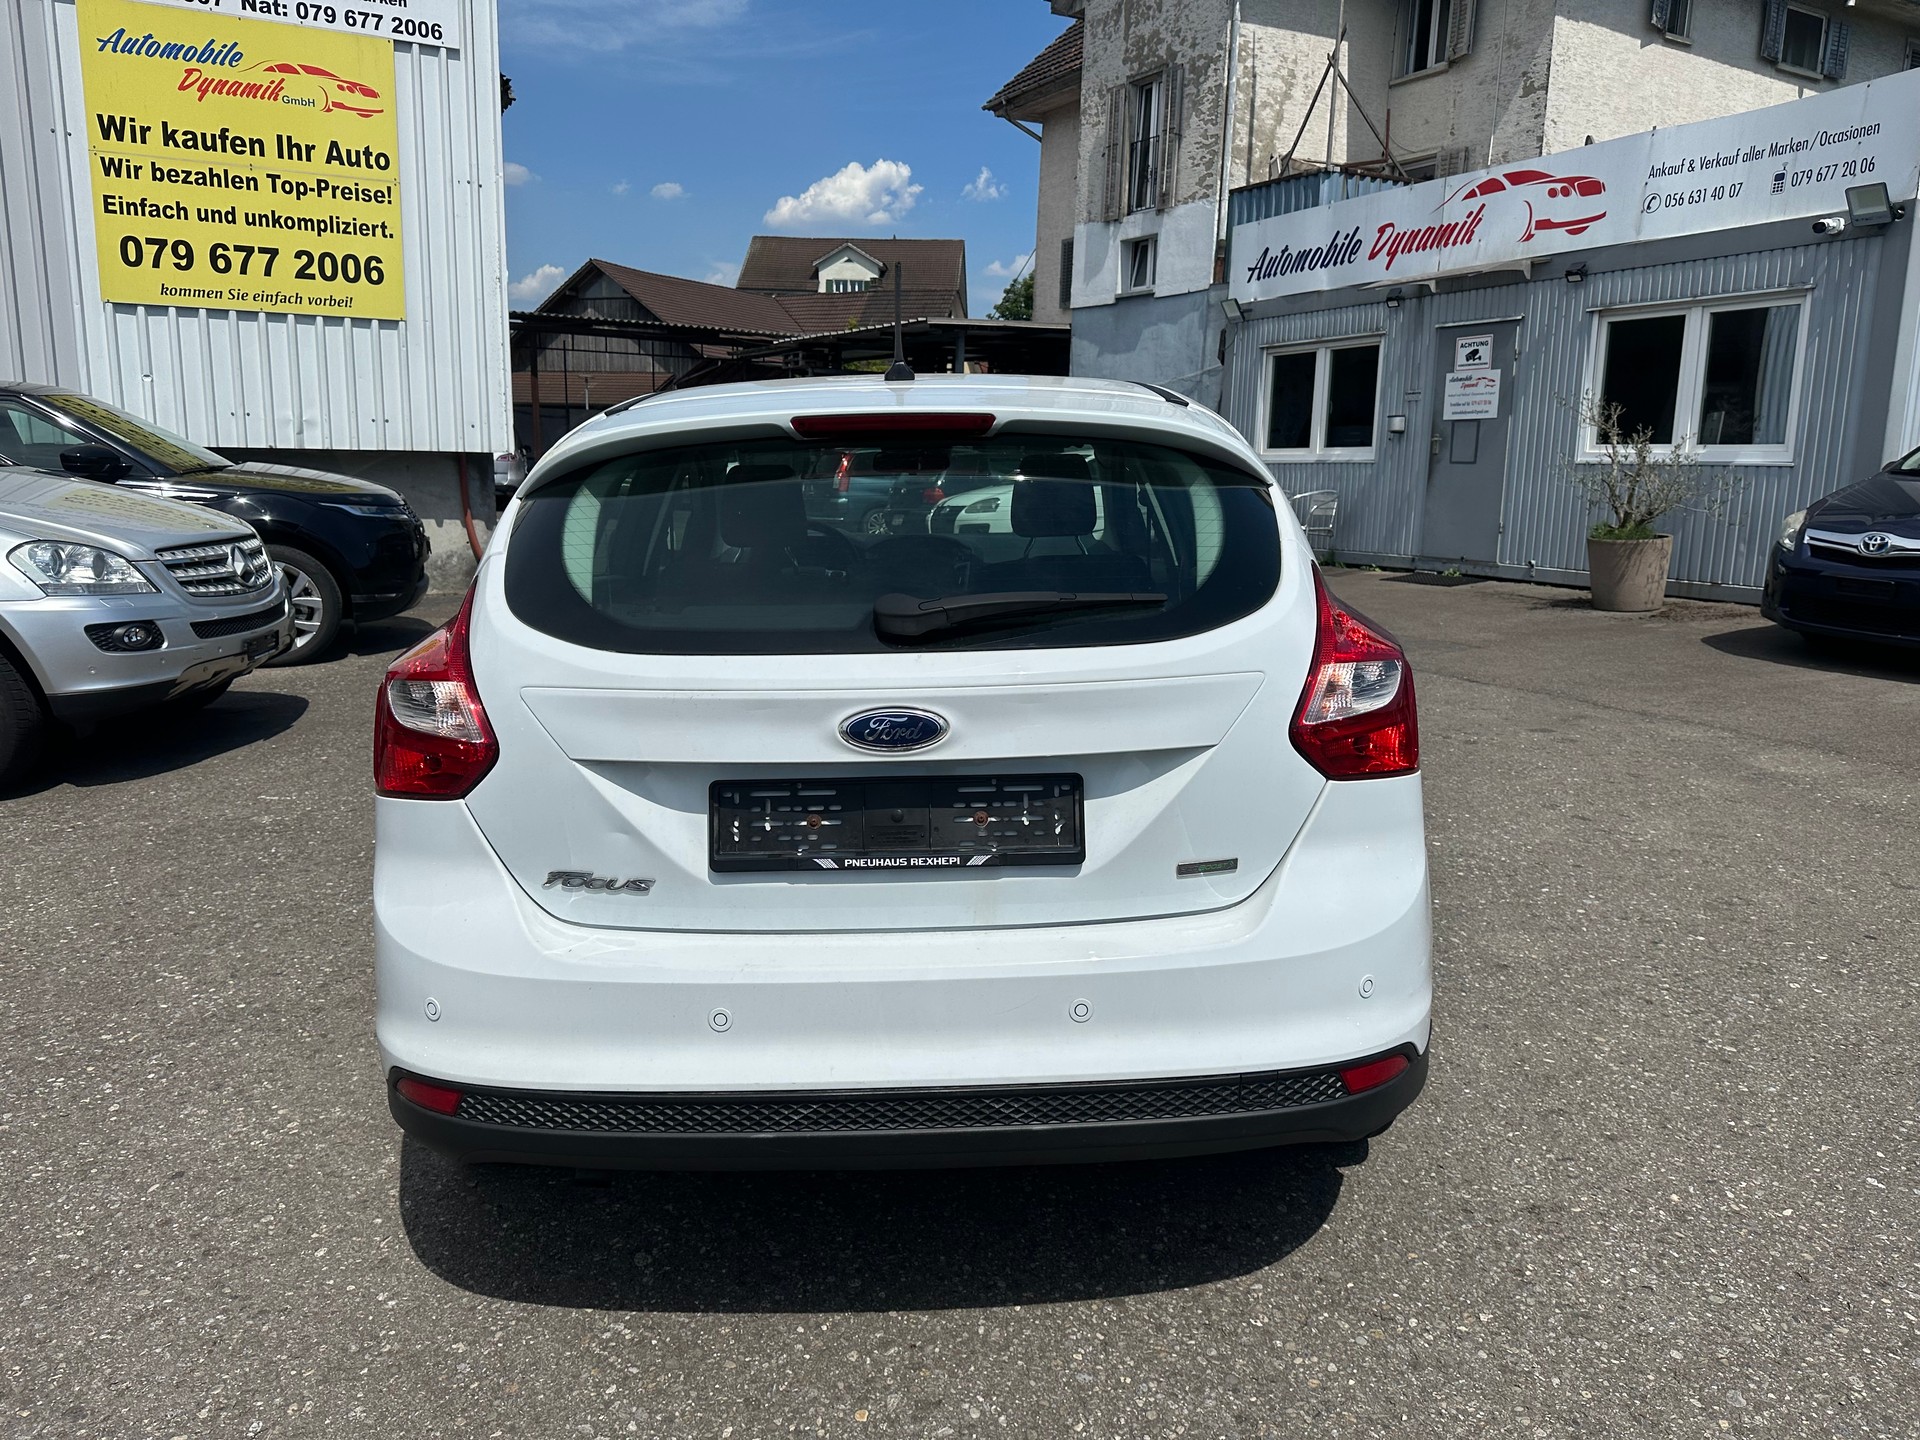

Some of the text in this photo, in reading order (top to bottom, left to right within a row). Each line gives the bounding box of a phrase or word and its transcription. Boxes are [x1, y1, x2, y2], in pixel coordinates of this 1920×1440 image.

[296, 1, 336, 24] 079
[344, 9, 384, 31] 677
[391, 16, 443, 40] 2006
[96, 28, 243, 67] Automobile
[177, 68, 316, 107] Dynamik GmbH
[96, 113, 391, 171] Wir kaufen Ihr Auto
[99, 156, 393, 205] Wir bezahlen Top-Preise!
[1648, 158, 1685, 179] Ankauf
[1687, 160, 1696, 172] &
[1699, 148, 1740, 171] Verkauf
[1742, 146, 1766, 163] aller
[1791, 156, 1875, 187] 079 677 20 06
[1665, 182, 1743, 208] 056 631 40 07
[102, 194, 395, 239] Einfach und unkompliziert.
[119, 235, 385, 286] 079 677 2006
[1247, 203, 1486, 283] Automobile Dynamik
[160, 283, 354, 309] kommen Sie einfach vorbei!
[1460, 340, 1489, 349] ACHTUNG
[864, 716, 923, 741] Ford
[844, 856, 960, 867] PNEUHAUS REXHEPI
